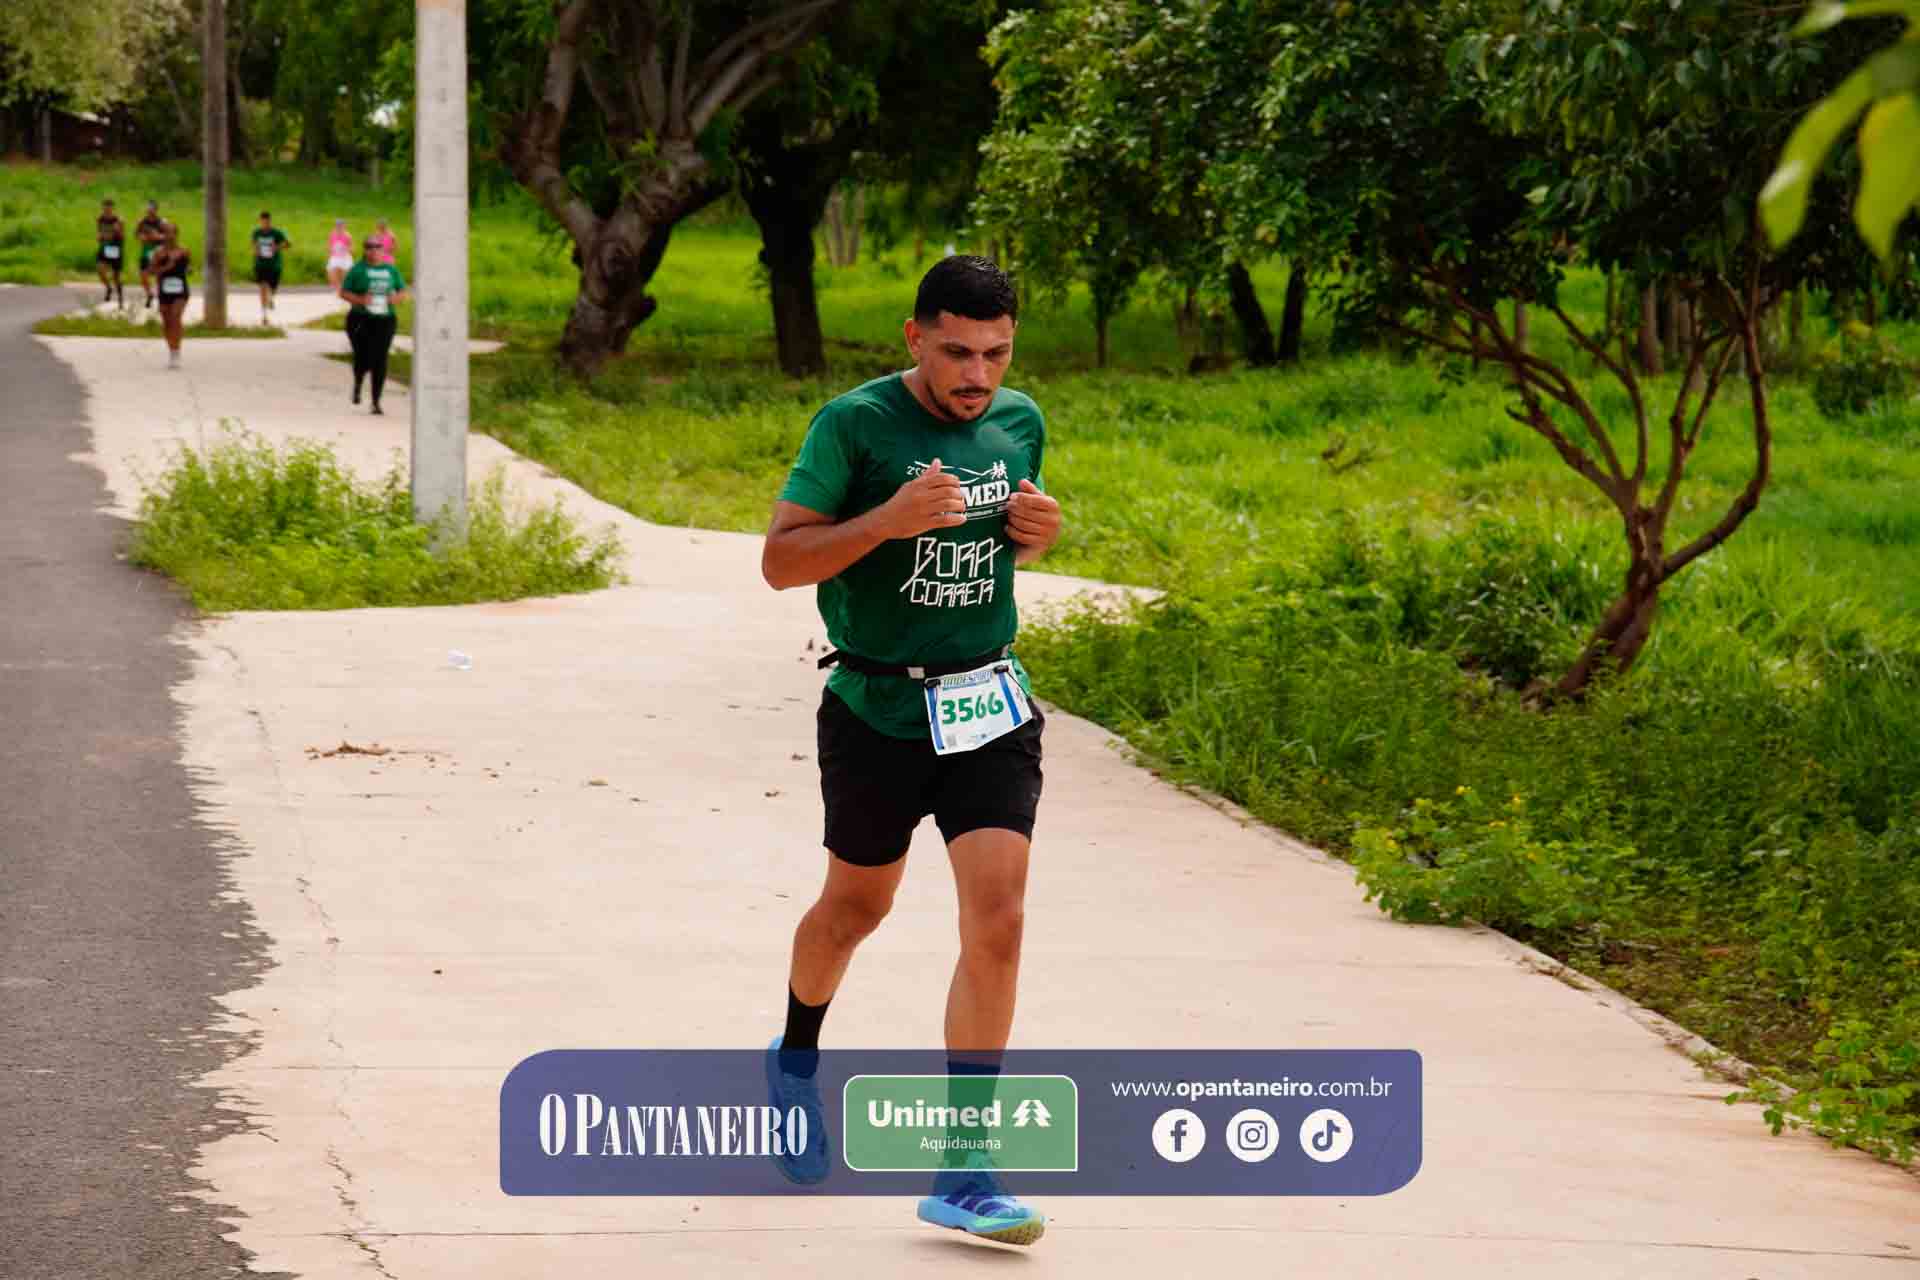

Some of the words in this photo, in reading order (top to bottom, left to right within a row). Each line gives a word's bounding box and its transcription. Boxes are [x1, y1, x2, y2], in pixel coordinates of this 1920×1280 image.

[960, 480, 1010, 507] MED
[900, 537, 1003, 592] BORA
[911, 578, 995, 607] CORRER
[941, 692, 1004, 725] 3566
